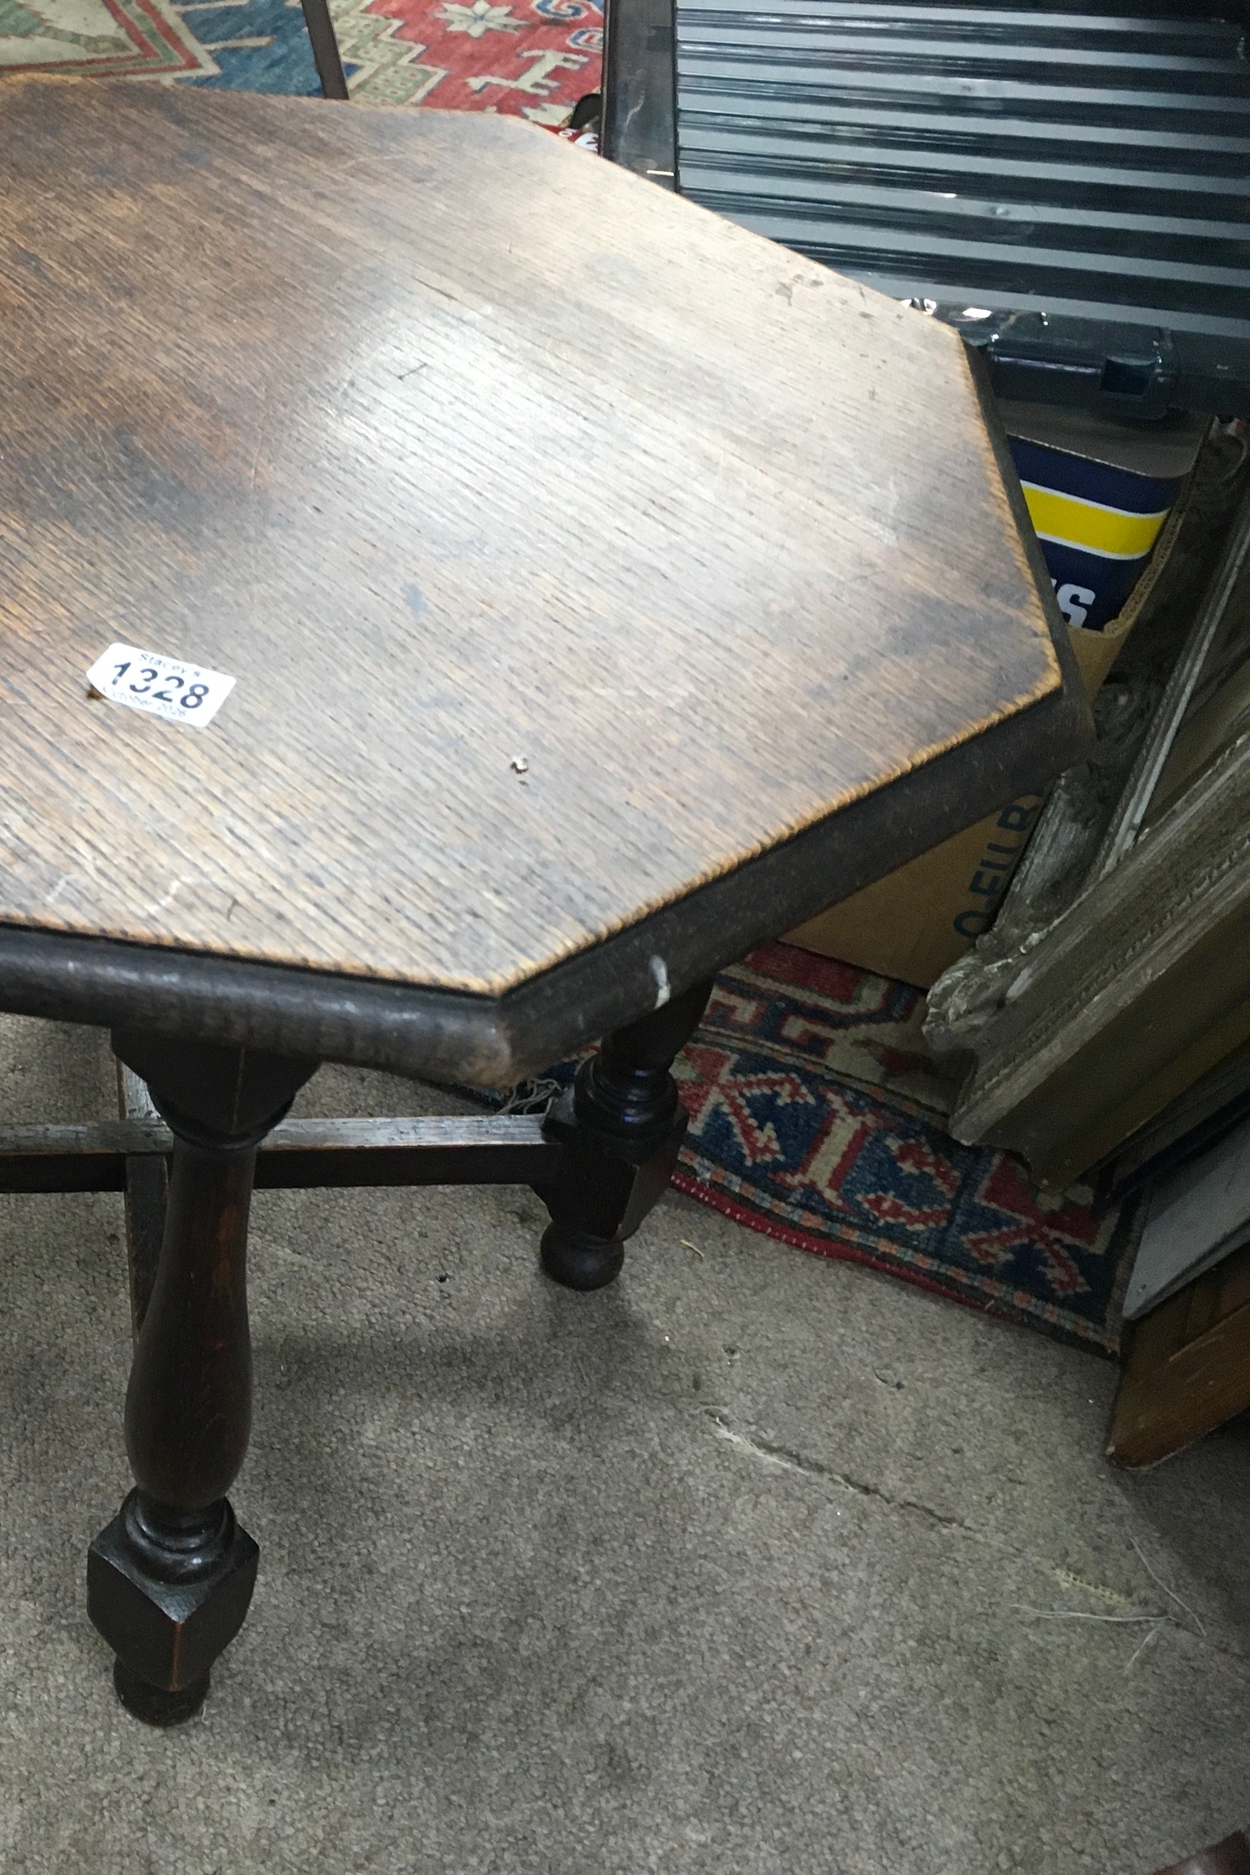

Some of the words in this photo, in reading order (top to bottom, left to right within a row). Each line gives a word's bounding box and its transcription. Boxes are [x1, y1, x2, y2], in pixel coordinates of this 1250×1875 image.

[138, 653, 201, 678] Stacey's
[102, 686, 154, 707] October
[111, 661, 210, 709] 1328
